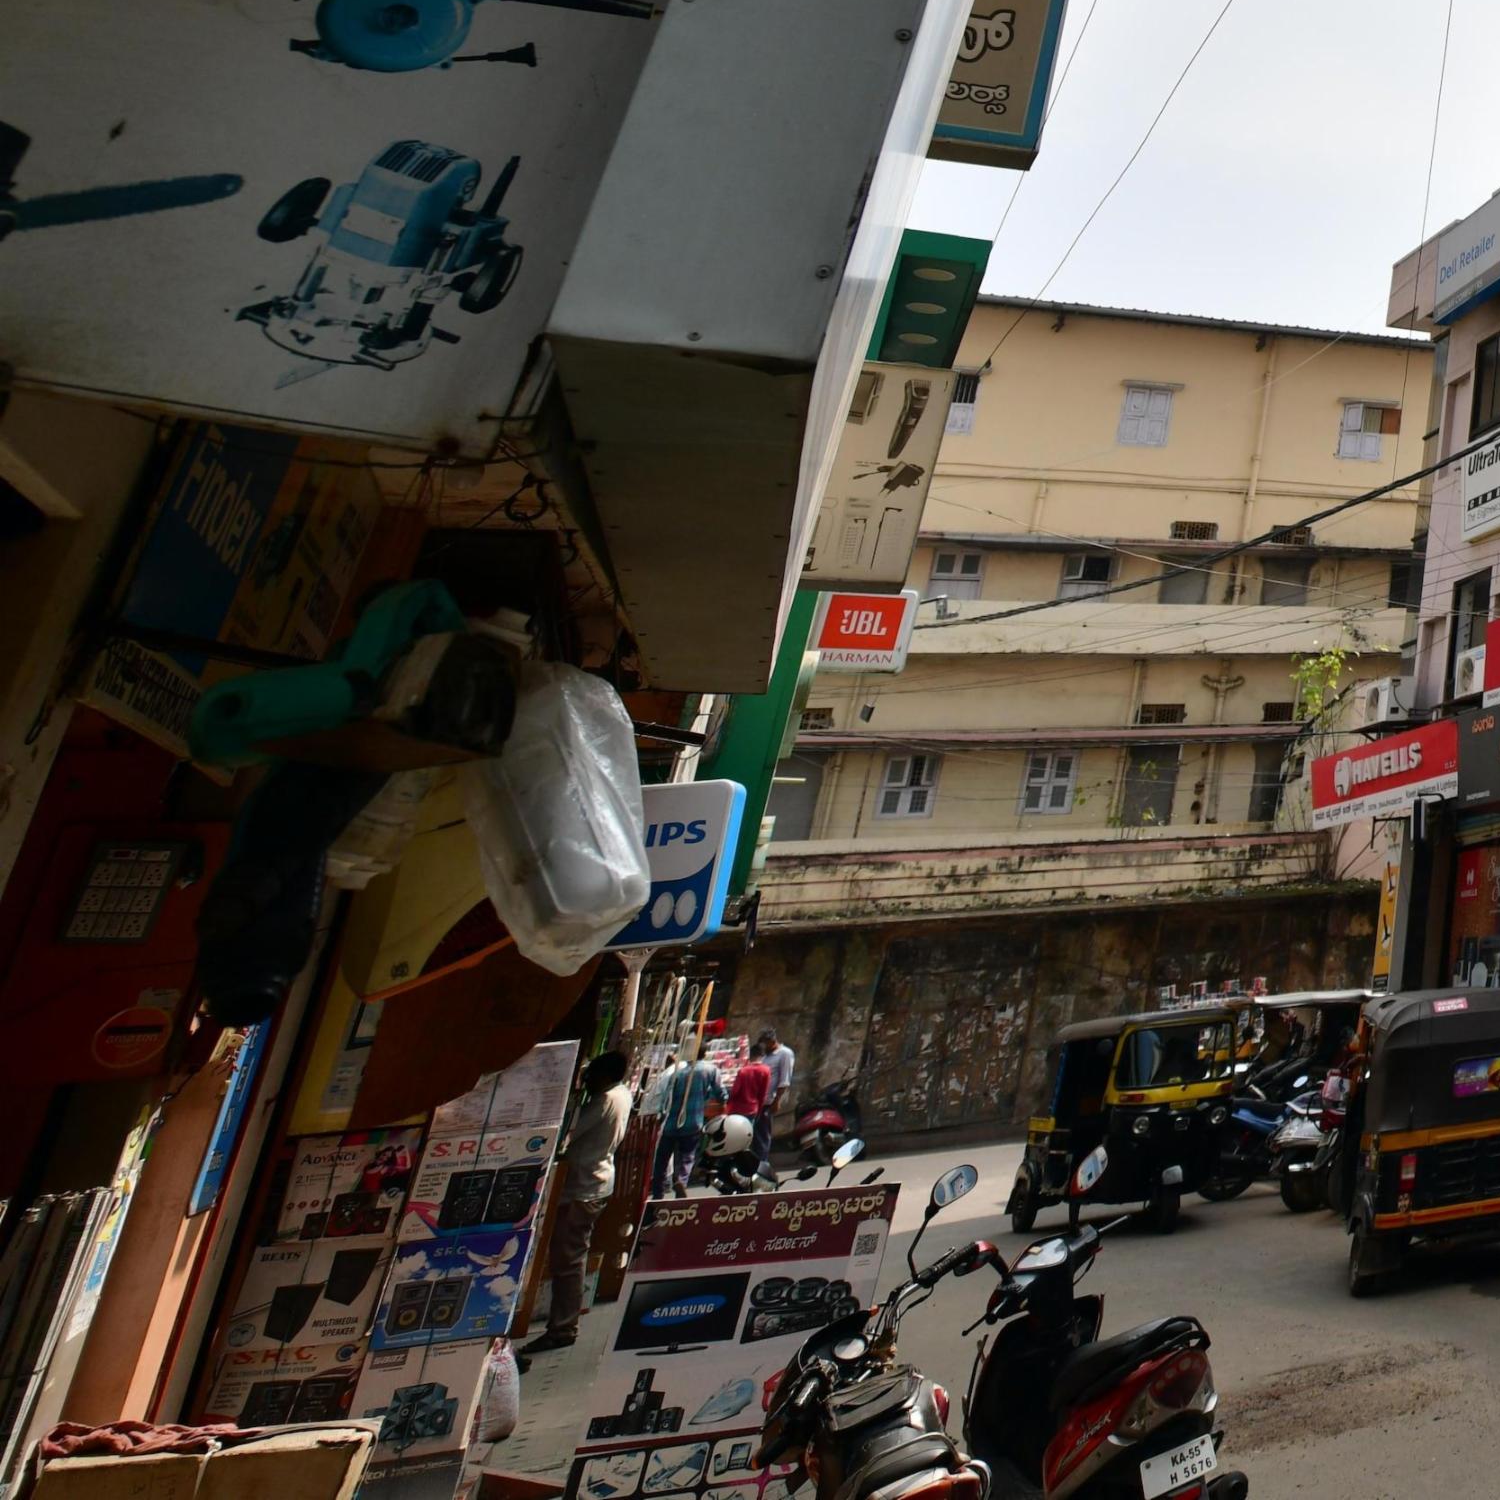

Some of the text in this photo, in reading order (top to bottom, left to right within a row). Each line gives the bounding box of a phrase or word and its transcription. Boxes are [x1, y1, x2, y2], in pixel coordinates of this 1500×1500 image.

[1439, 232, 1496, 285] Dell Retailer
[839, 609, 887, 636] JBL
[822, 651, 893, 665] HARMAN
[1352, 742, 1422, 785] HAVELLS
[260, 1251, 303, 1262] BEATS
[651, 1302, 716, 1318] SAMSUNG
[312, 1316, 359, 1328] MULTIMEDIA
[321, 1326, 356, 1337] SPEAKER
[1170, 1446, 1201, 1467] KA-55
[1170, 1457, 1212, 1484] H 5676
